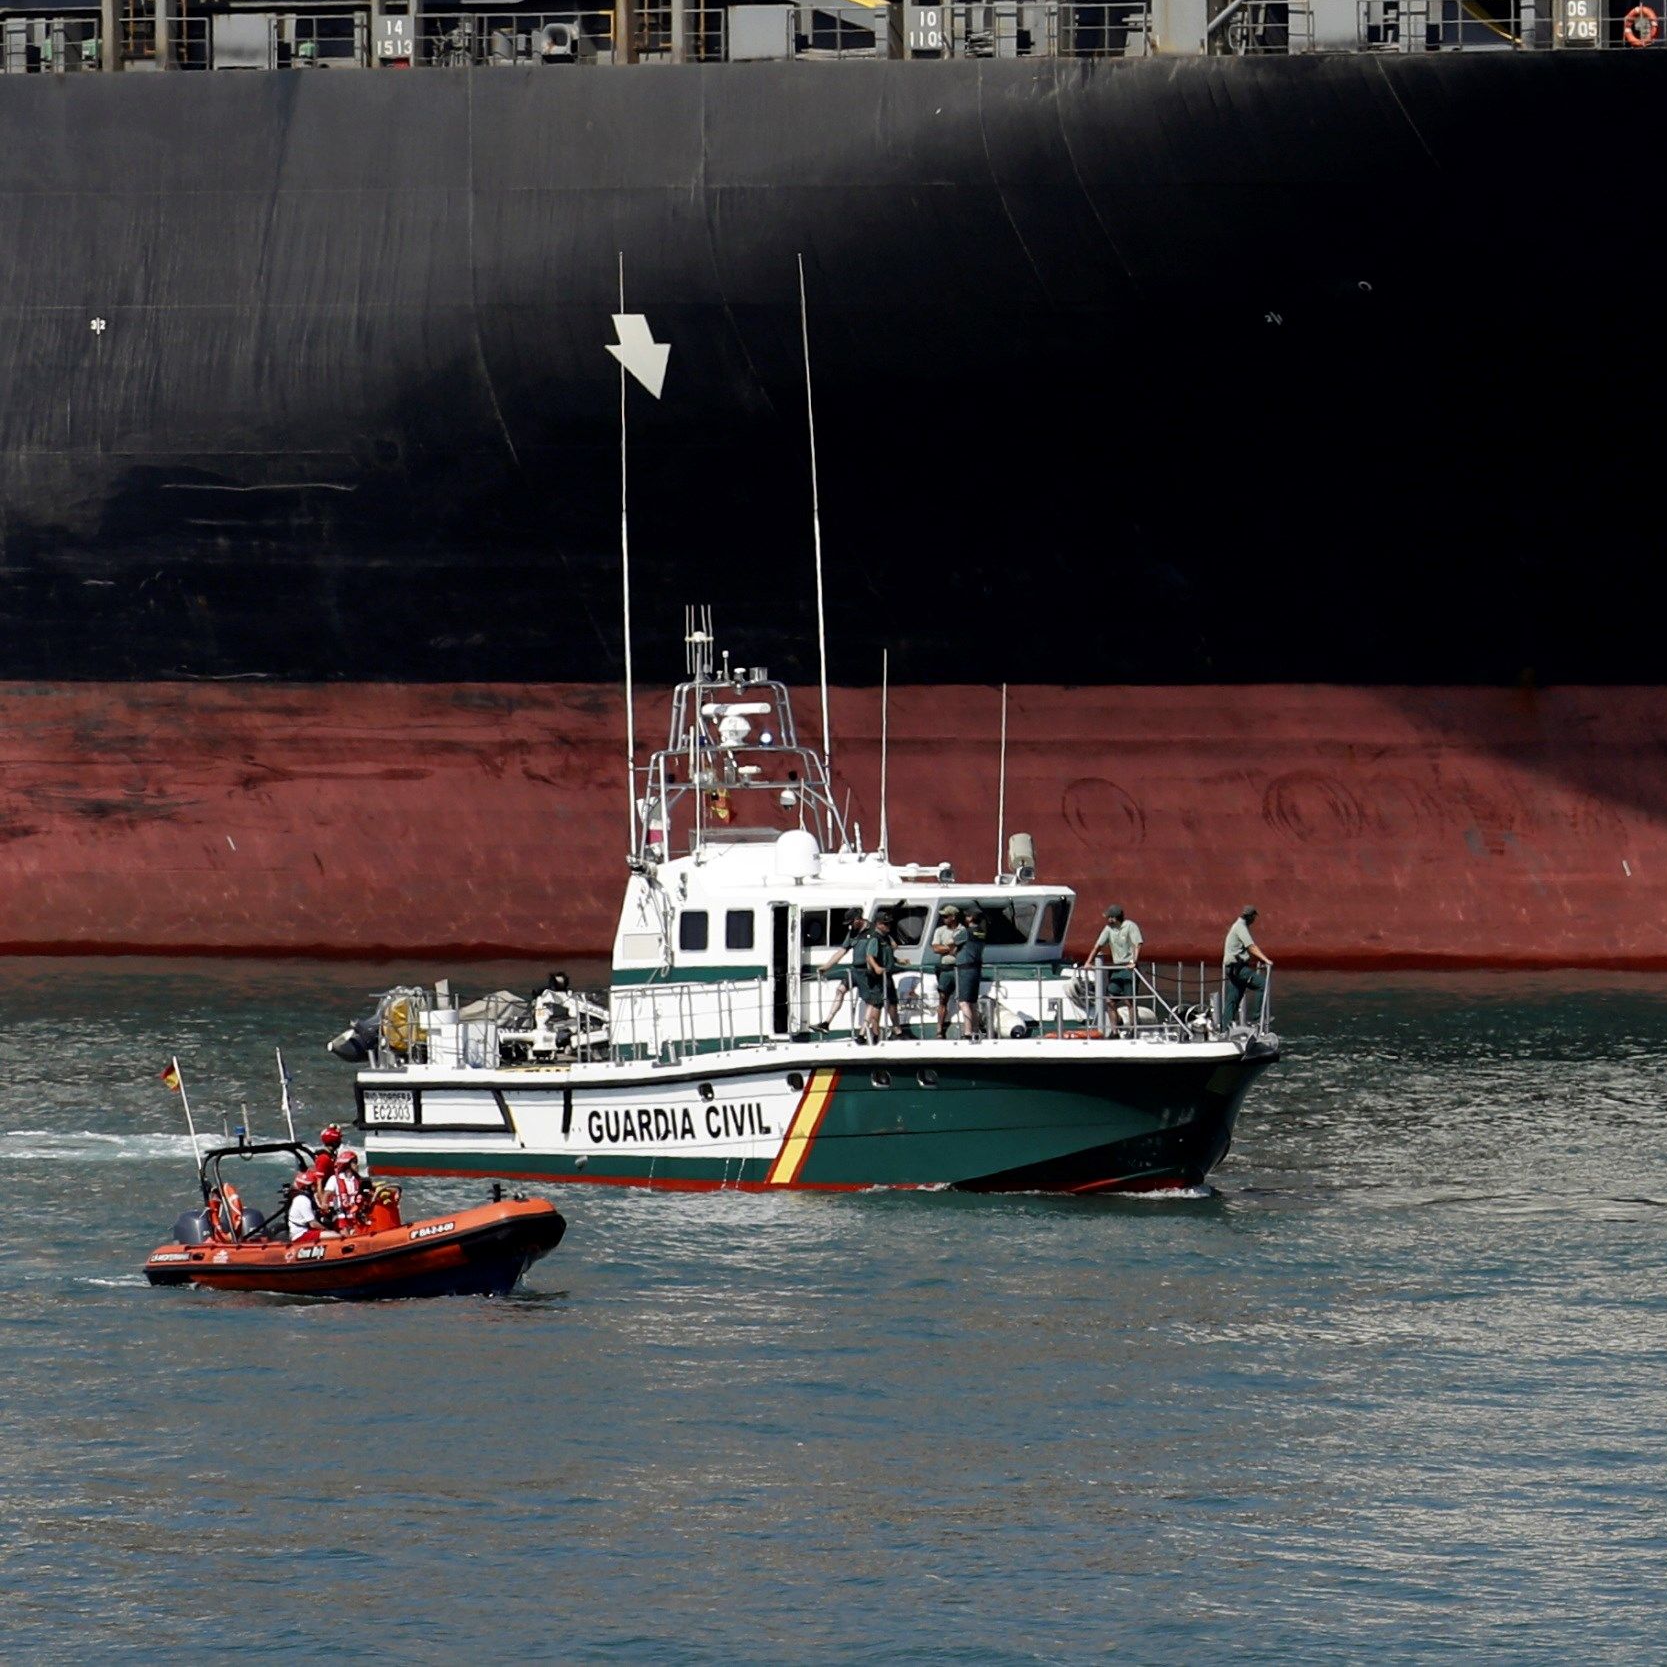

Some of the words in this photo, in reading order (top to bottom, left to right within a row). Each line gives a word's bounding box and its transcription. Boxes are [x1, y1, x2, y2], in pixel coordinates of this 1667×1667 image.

[1566, 0, 1588, 17] 06
[386, 19, 403, 35] 14
[919, 11, 937, 27] 10
[587, 1107, 696, 1144] GUARDIA
[705, 1102, 772, 1138] CIVIL
